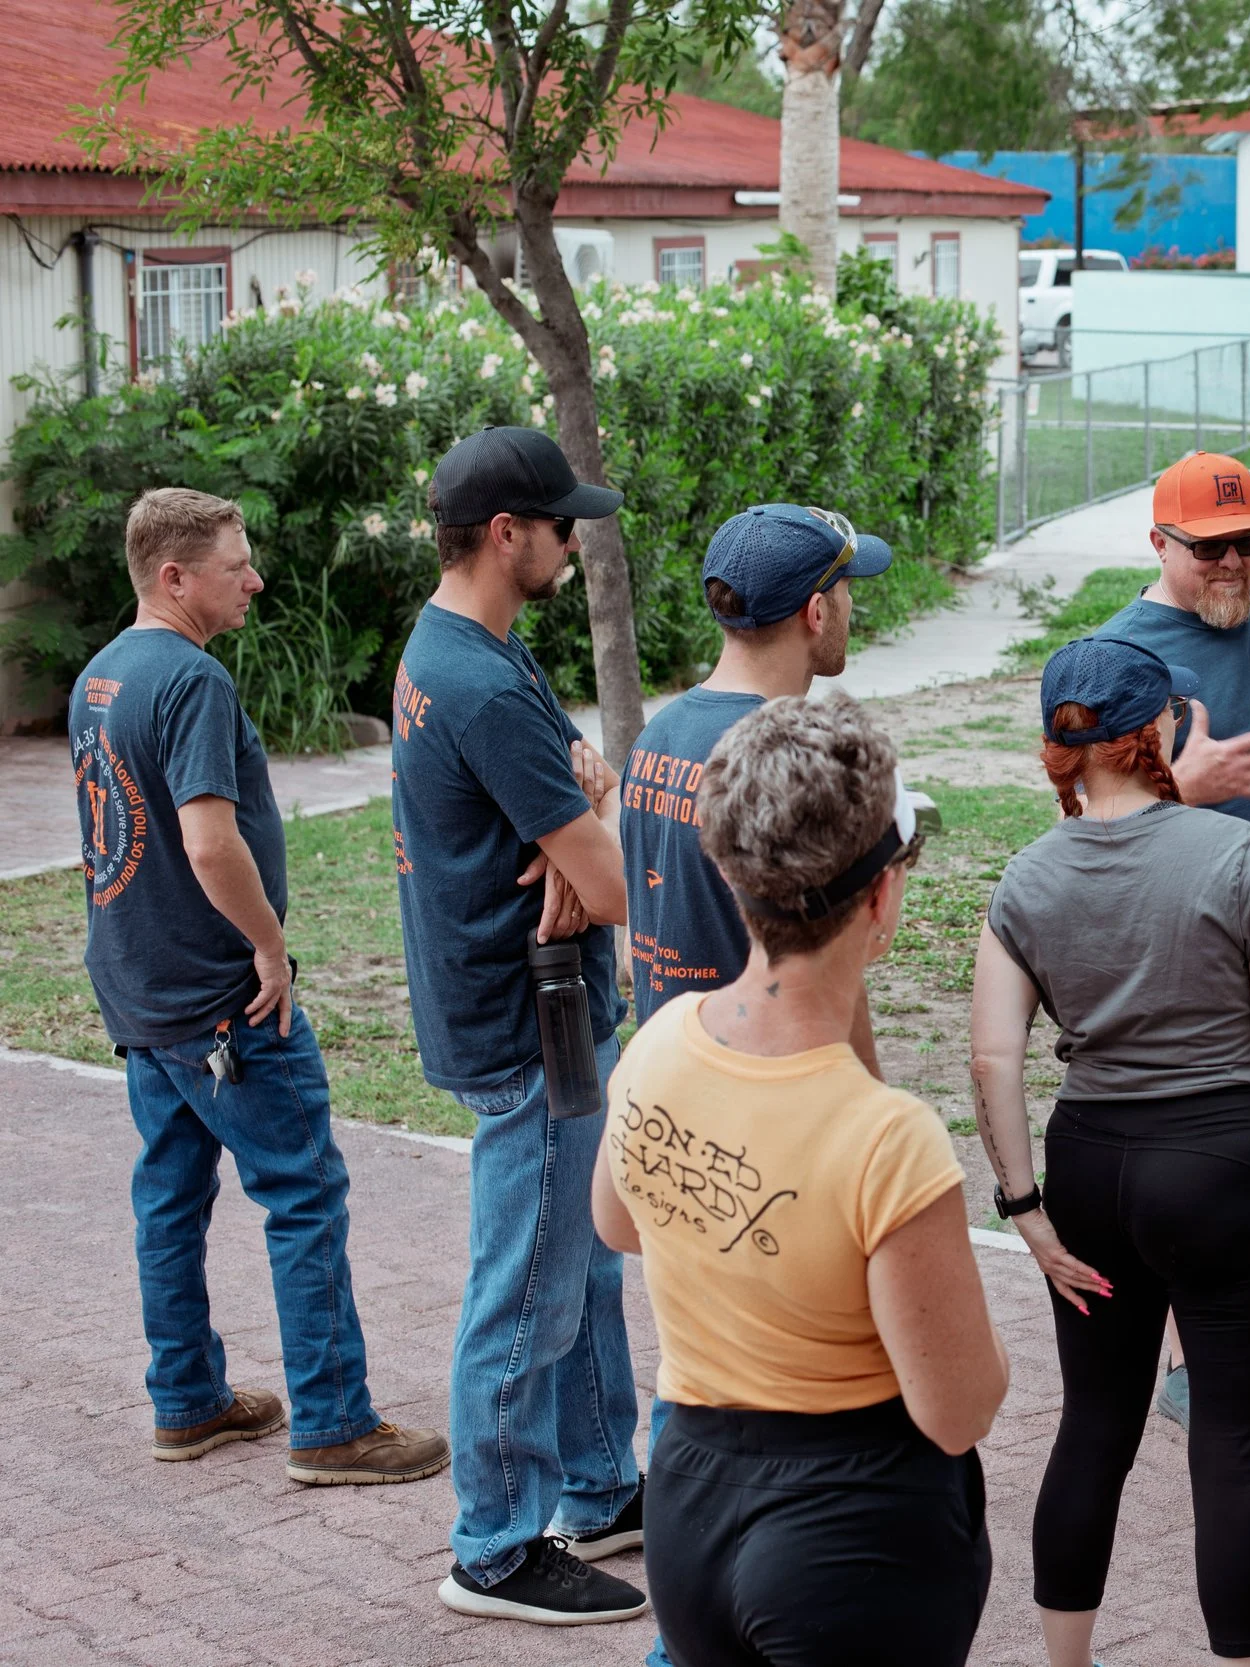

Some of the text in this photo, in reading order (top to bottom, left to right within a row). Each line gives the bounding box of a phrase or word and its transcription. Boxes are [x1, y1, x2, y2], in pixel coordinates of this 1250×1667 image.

[1222, 481, 1238, 497] CR
[114, 760, 145, 806] loved
[114, 799, 128, 830] serve
[128, 806, 147, 838] you,
[131, 840, 145, 859] so
[119, 856, 140, 886] you
[658, 945, 681, 962] YOU,
[664, 965, 720, 979] ANOTHER.
[619, 1172, 707, 1234] designs
